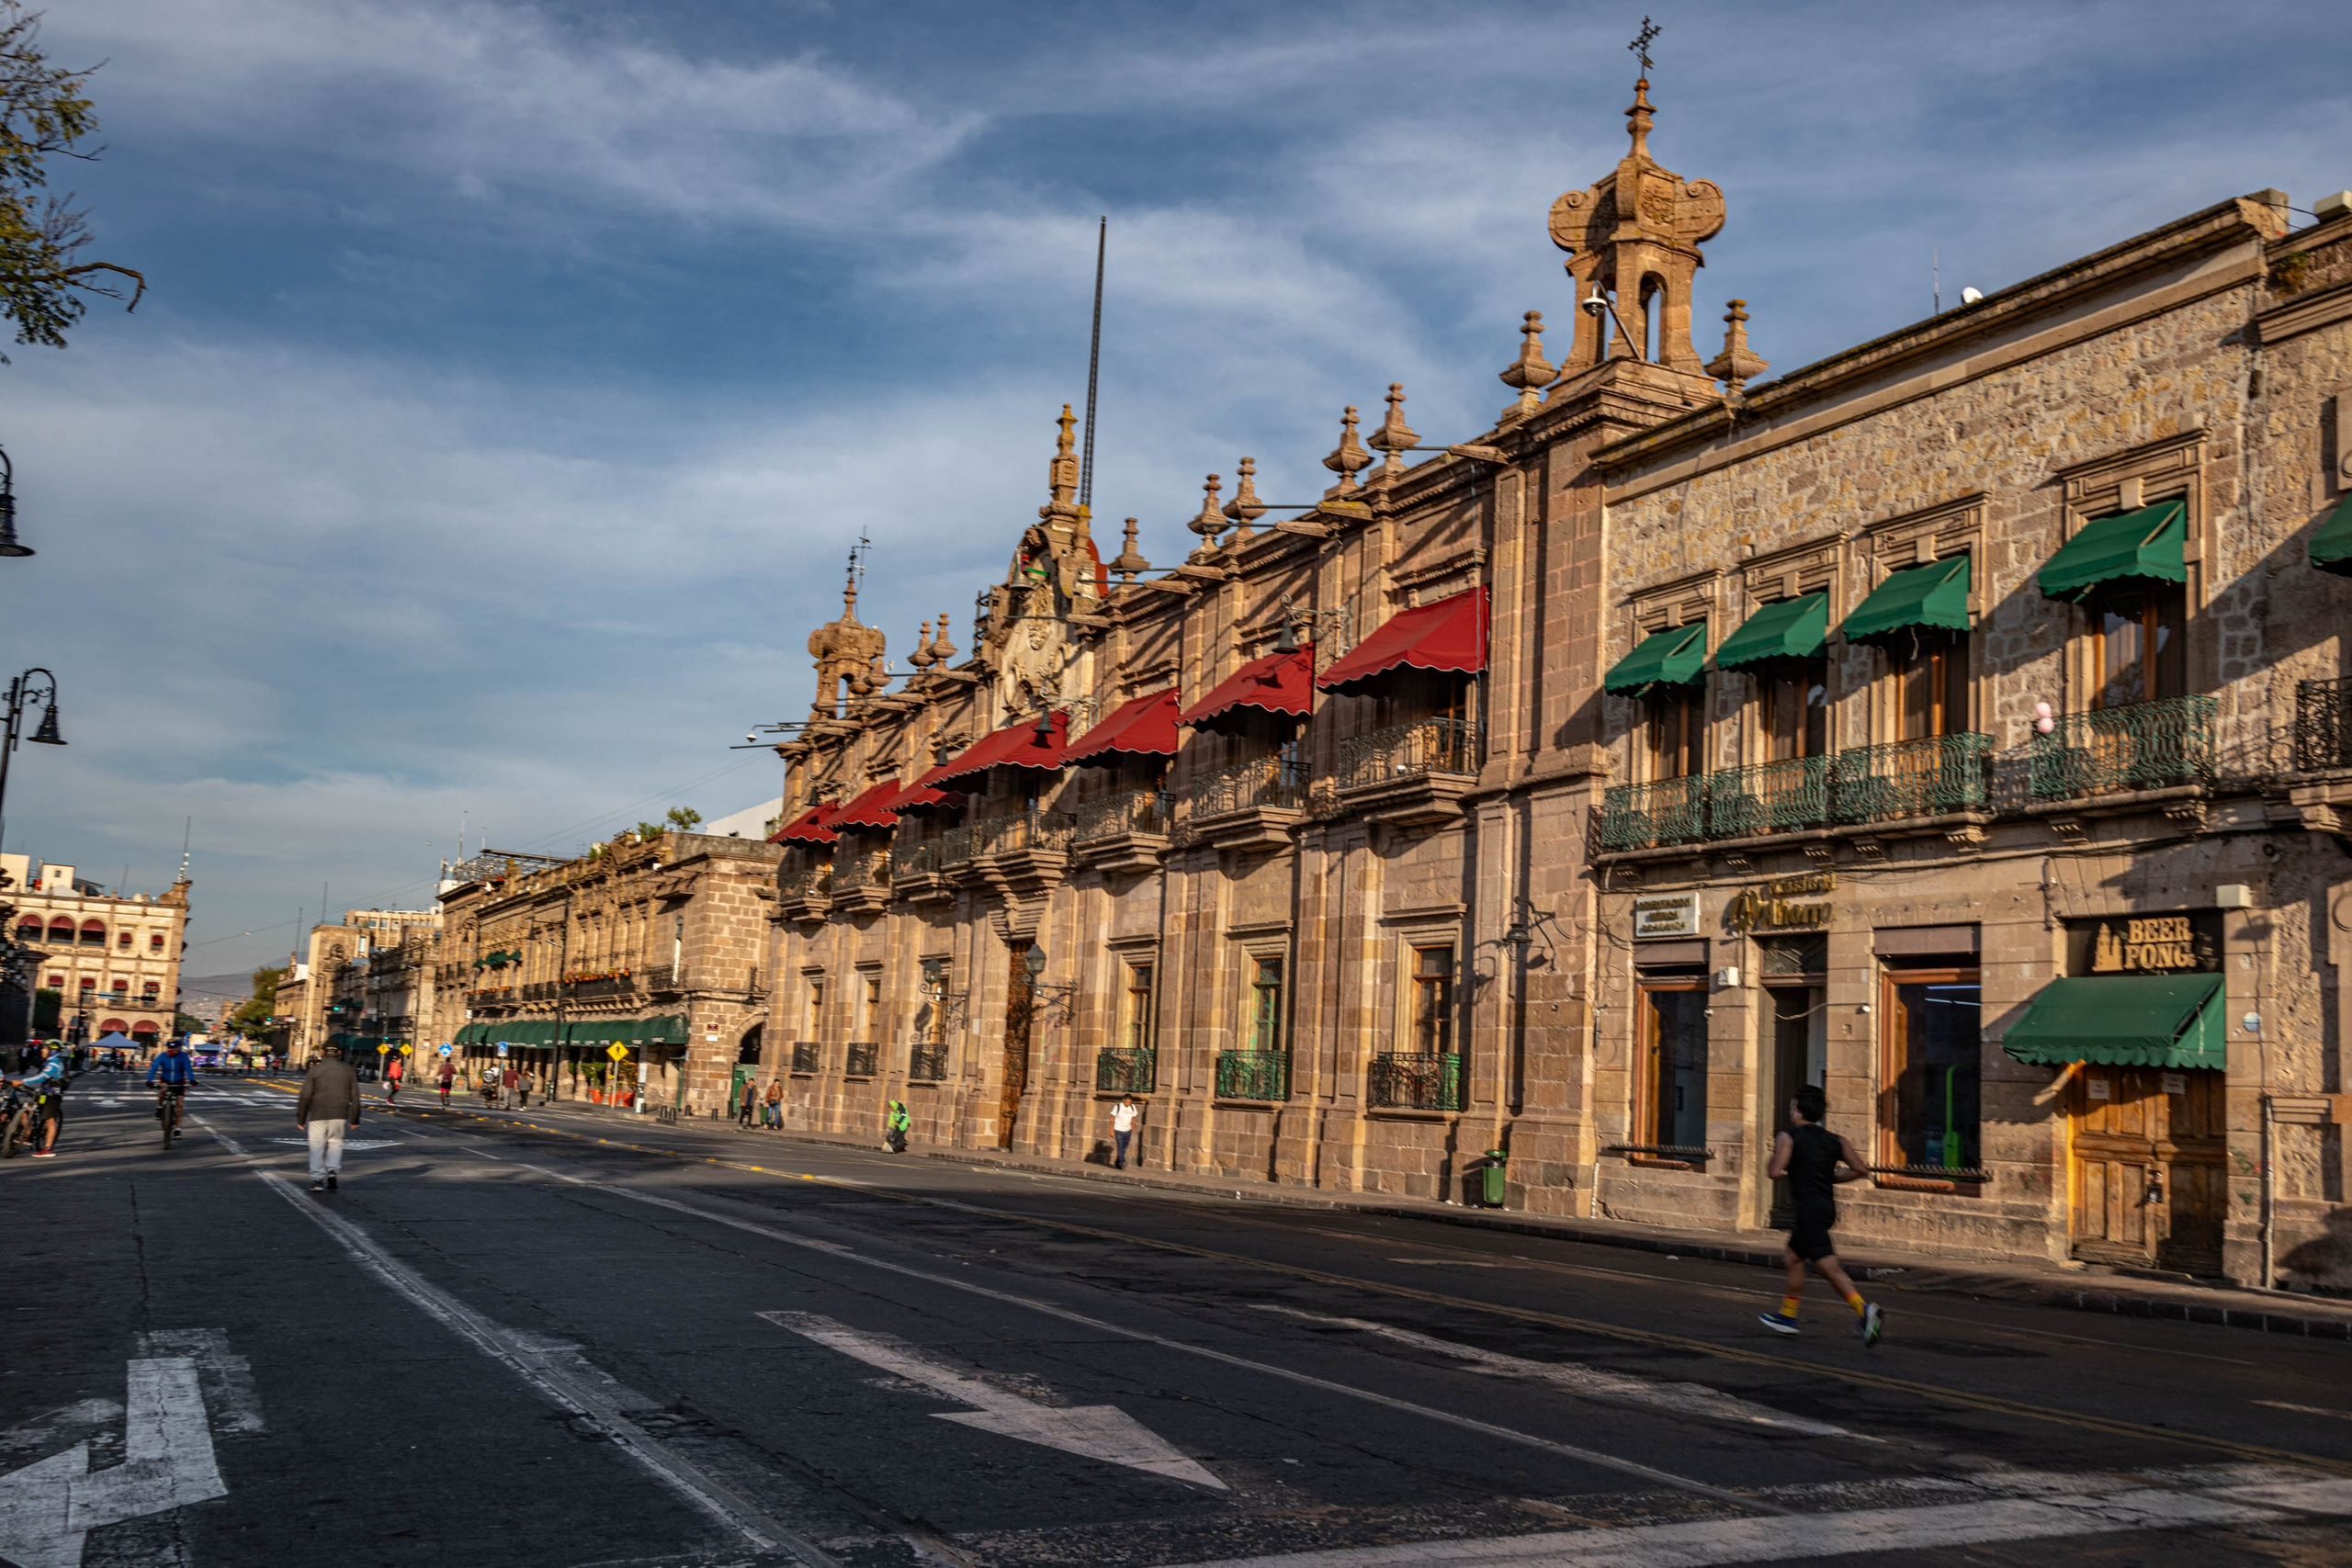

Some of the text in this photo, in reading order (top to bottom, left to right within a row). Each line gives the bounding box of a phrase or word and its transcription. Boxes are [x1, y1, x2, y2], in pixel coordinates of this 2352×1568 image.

[1763, 899, 1832, 926] Ahorro
[2129, 918, 2193, 942] BEER
[2125, 943, 2196, 969] PONG
